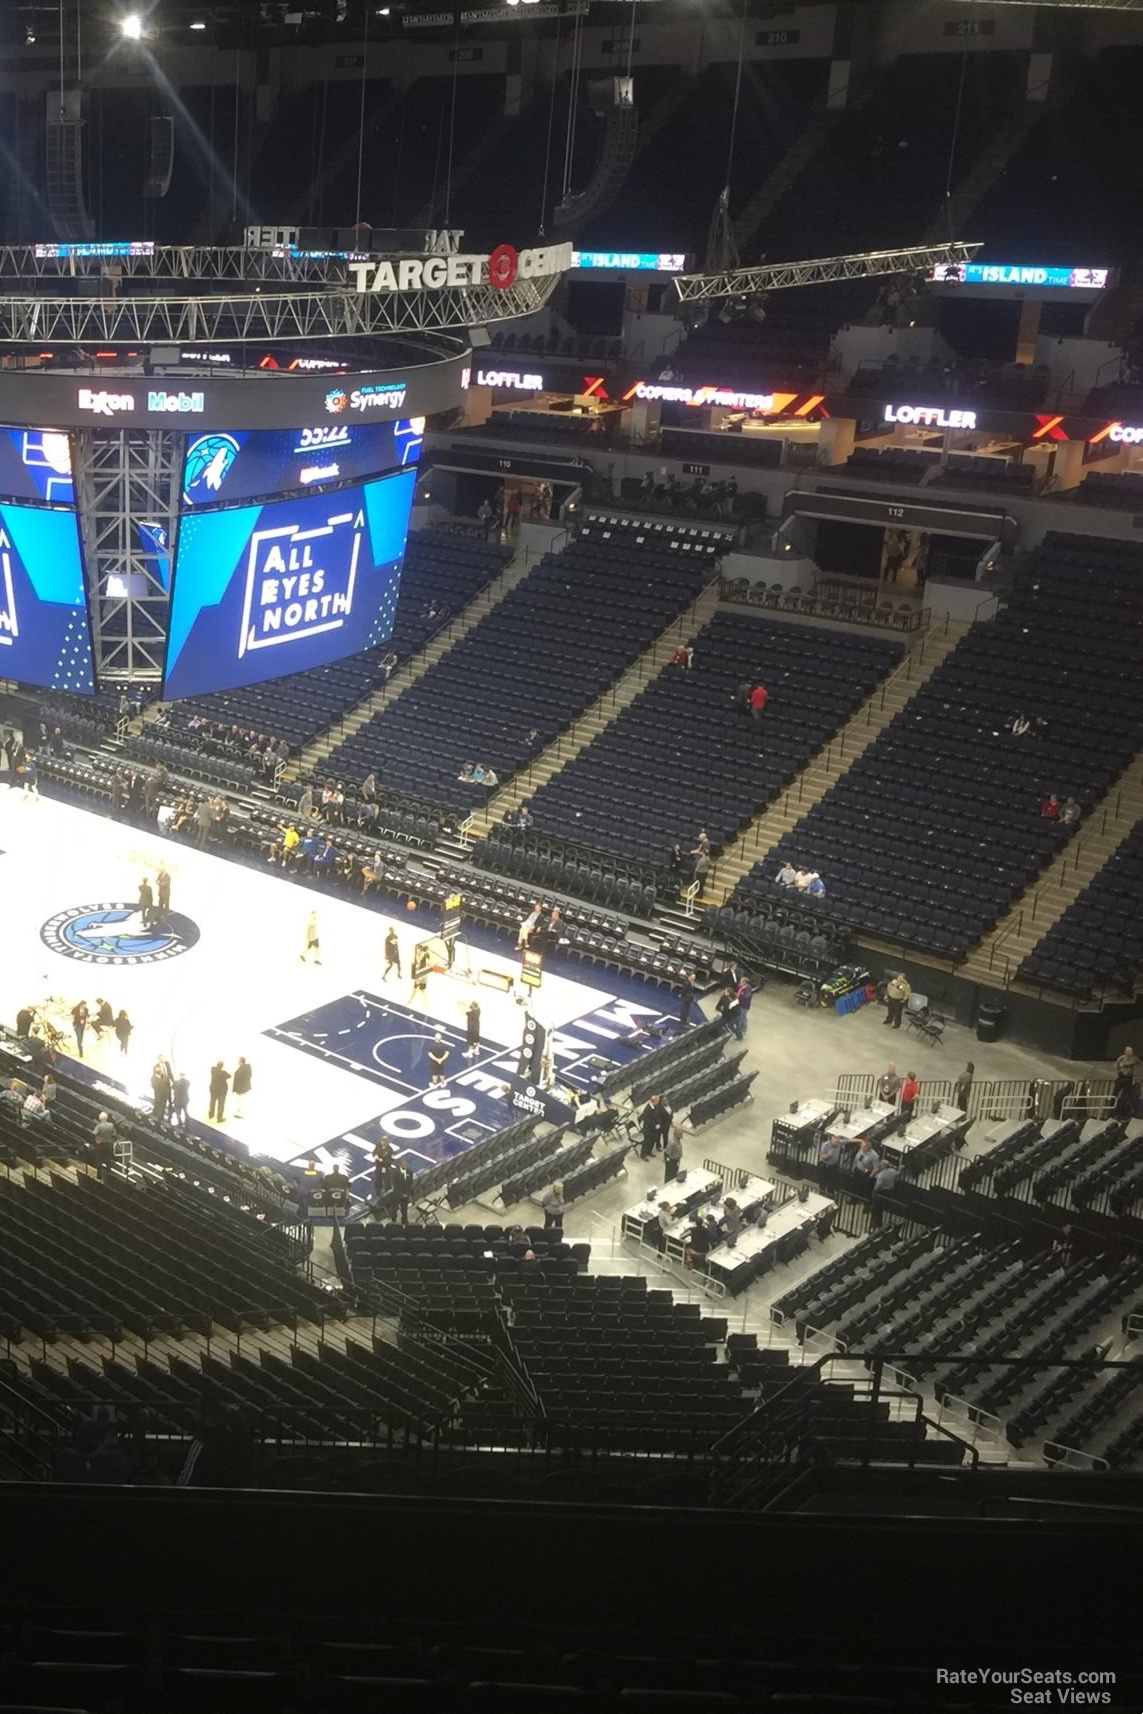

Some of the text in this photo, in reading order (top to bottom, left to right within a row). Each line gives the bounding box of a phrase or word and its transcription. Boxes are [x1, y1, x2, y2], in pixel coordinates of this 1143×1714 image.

[958, 23, 978, 34] 211
[768, 33, 787, 44] 210
[593, 252, 641, 268] ISLAND
[349, 253, 490, 293] TARGET
[982, 266, 1049, 284] ISLAND
[1049, 277, 1068, 285] TIME
[477, 370, 543, 391] LOFFLER
[78, 389, 205, 416] Exxon Mobil
[349, 389, 406, 409] Synergy
[884, 404, 977, 429] LOFFLER
[499, 459, 512, 469] 110
[689, 465, 703, 474] 111
[888, 507, 904, 518] 112
[262, 545, 314, 573] ALL
[260, 569, 325, 606] EYES
[262, 592, 349, 632] NORTH
[512, 1098, 545, 1117] CENTER
[513, 1091, 546, 1110] TARGET
